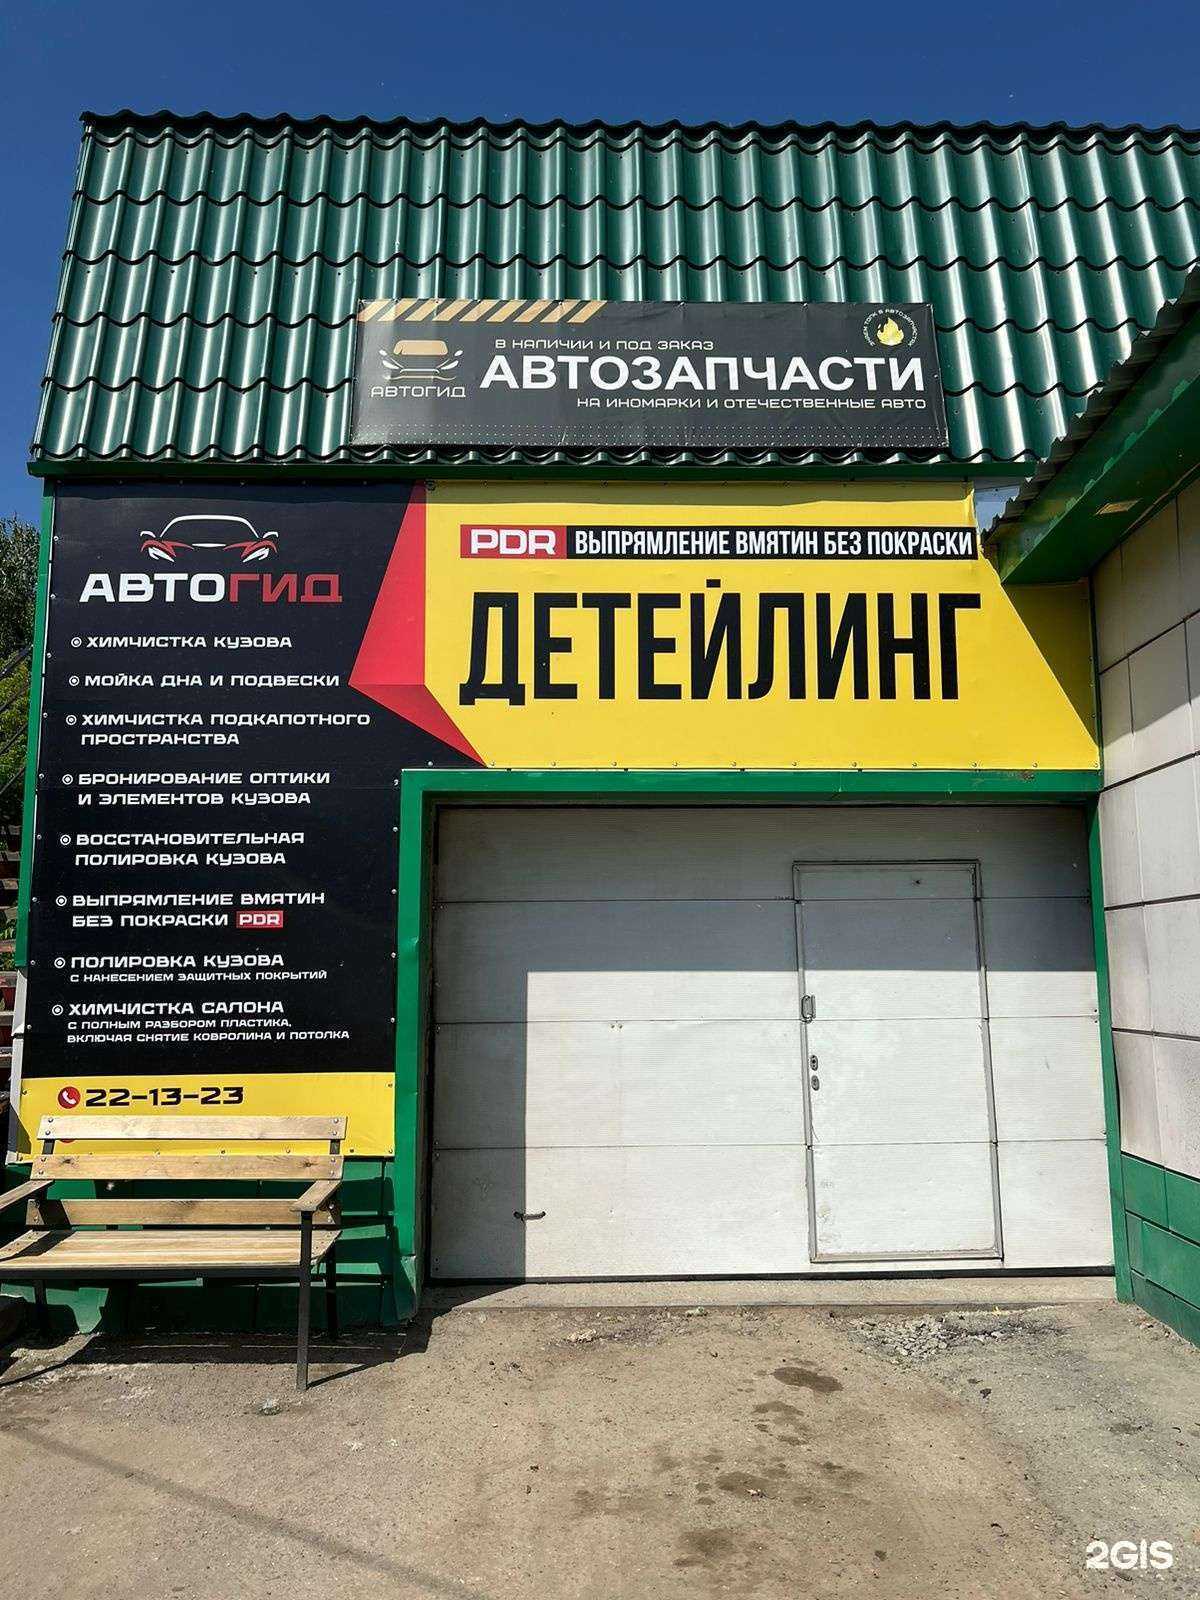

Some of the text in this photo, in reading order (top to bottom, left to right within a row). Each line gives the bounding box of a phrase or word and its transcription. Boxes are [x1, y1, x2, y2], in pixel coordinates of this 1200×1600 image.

[496, 339, 713, 350] В НАЛИЧИИ И ПОД ЗАКАЗ
[480, 355, 924, 391] АВТОЗАПЧАСТИ
[370, 387, 466, 399] АВТОГИД
[578, 398, 926, 408] НА ИНОМАРКИ И ОТЕЧЕСТВЕННЫЕ АВТО
[471, 529, 972, 555] PDR ВЫПРЯМЛЕНИЕ ВМЯТИН БЕЗ ПОКРАСКИ
[80, 574, 341, 602] АВТОГИД
[87, 637, 292, 648] ХИМЧИСТКА КУЗОВА
[460, 579, 981, 705] ДЕТЕЙЛИНГ
[85, 673, 339, 687] МОЙКА ДНА И ПОДВЕСКИ
[82, 714, 370, 726] ХИМЧИСТКА ПОДКАПОТНОГО
[82, 734, 239, 745] ПРОСТРАНСТВА
[79, 773, 329, 784] БРОНИРОВАНИЕ ОПТИКИ
[79, 793, 310, 805] И ЭЛЕМЕНТОВ КУЗОВА
[77, 833, 304, 845] ВОССТАНОВИТЕЛЬНАЯ
[76, 853, 285, 865] ПОЛИРОВКА КУЗОВА
[73, 893, 324, 906] ВЫПРЯМЛЕНИЕ ВМЯТИН
[73, 911, 279, 927] БЕЗ ПОКРАСКИ PDR
[71, 955, 283, 968] ПОЛИРОВКА КУЗОВА
[178, 973, 251, 981] ЗАЩИТНЫХ
[256, 970, 326, 979] ПОКРЫТИЙ
[69, 1002, 283, 1015] ХИМЧИСТКА САЛОНА
[82, 1021, 140, 1029] ПОЛНЫМ
[146, 1020, 215, 1028] РАЗБОРОМ
[221, 1019, 291, 1027] ПЛАСТИКА,
[68, 1034, 132, 1042] ВКЛЮЧАЯ
[194, 1032, 271, 1040] КОВРОЛИНА
[290, 1031, 349, 1039] ПОТОЛКА
[86, 1087, 243, 1106] 22-13-23
